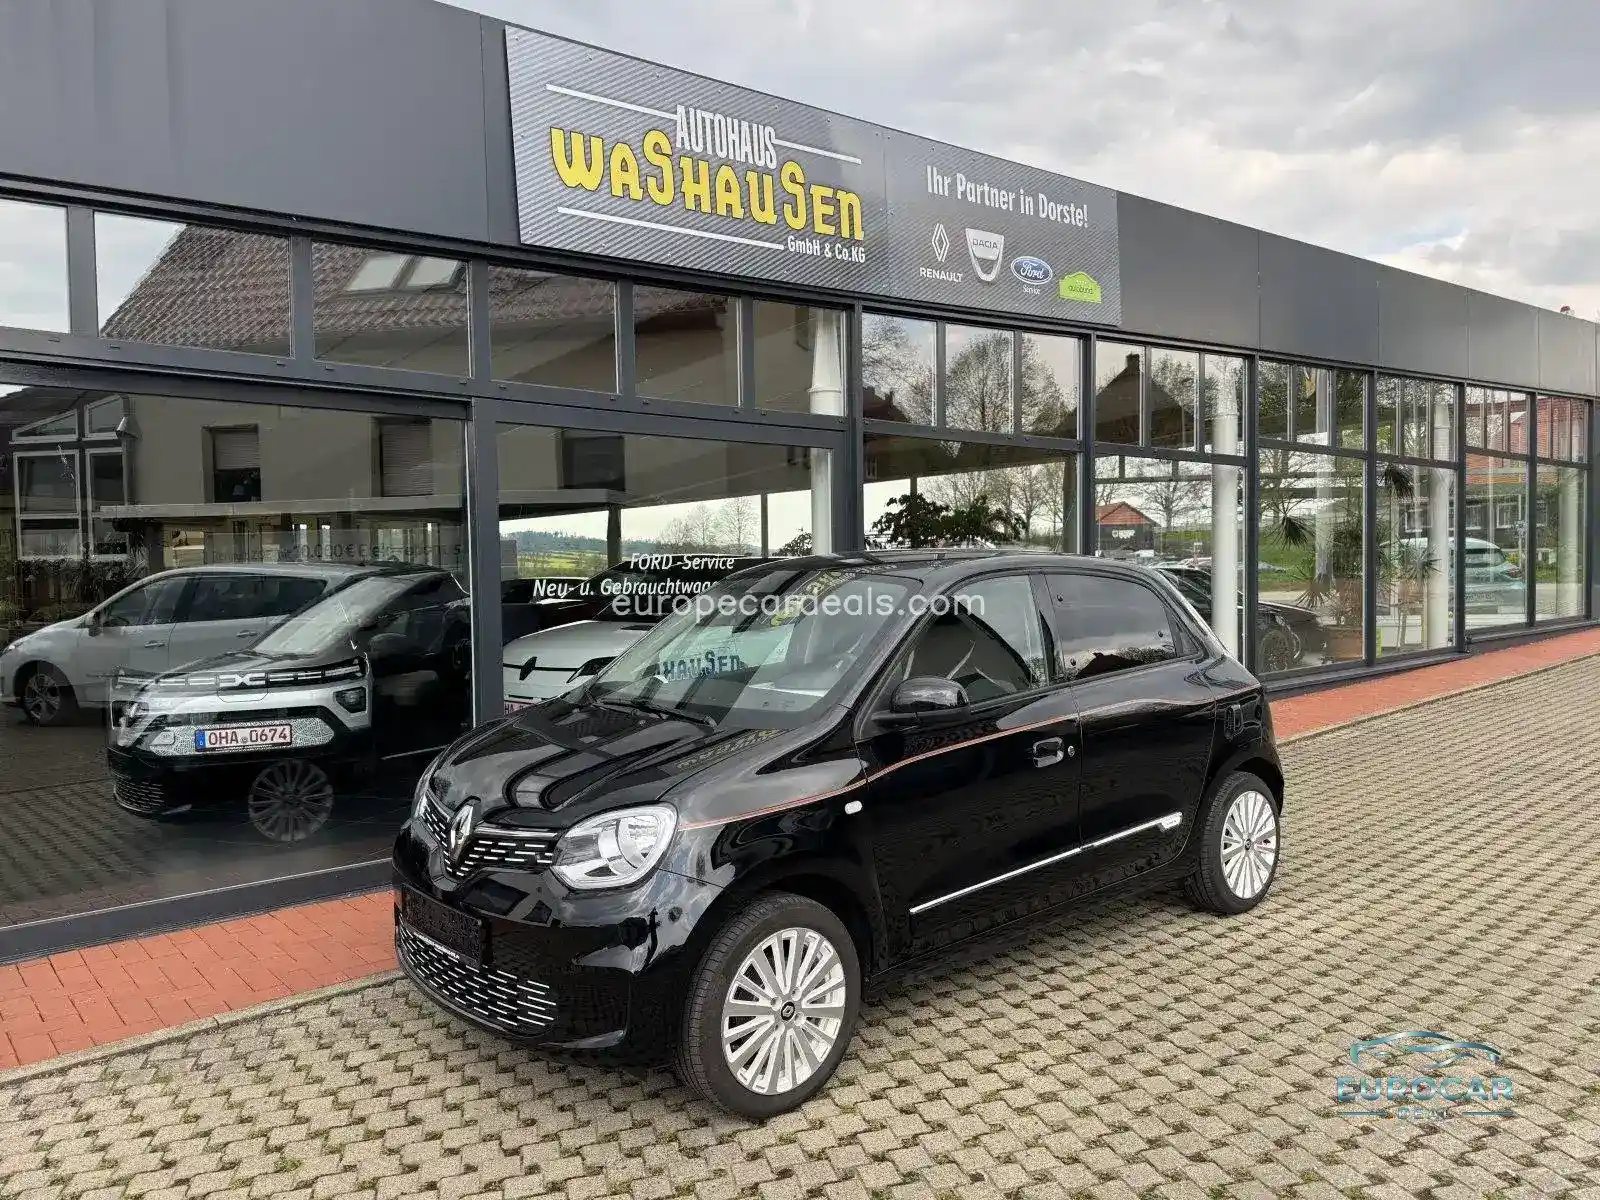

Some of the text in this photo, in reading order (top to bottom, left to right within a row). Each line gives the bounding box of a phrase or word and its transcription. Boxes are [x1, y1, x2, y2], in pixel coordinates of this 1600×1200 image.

[676, 104, 777, 170] AUTOHAUS
[926, 165, 1089, 228] Ihr Partner in Dorste!
[787, 235, 866, 263] GmbH & Co.KG
[972, 237, 998, 249] DACIA
[919, 267, 963, 283] RENAULT
[1020, 260, 1045, 279] Ford
[1022, 284, 1041, 295] Service
[629, 552, 672, 570] FORD
[579, 585, 594, 596] u.
[208, 731, 239, 746] OHA
